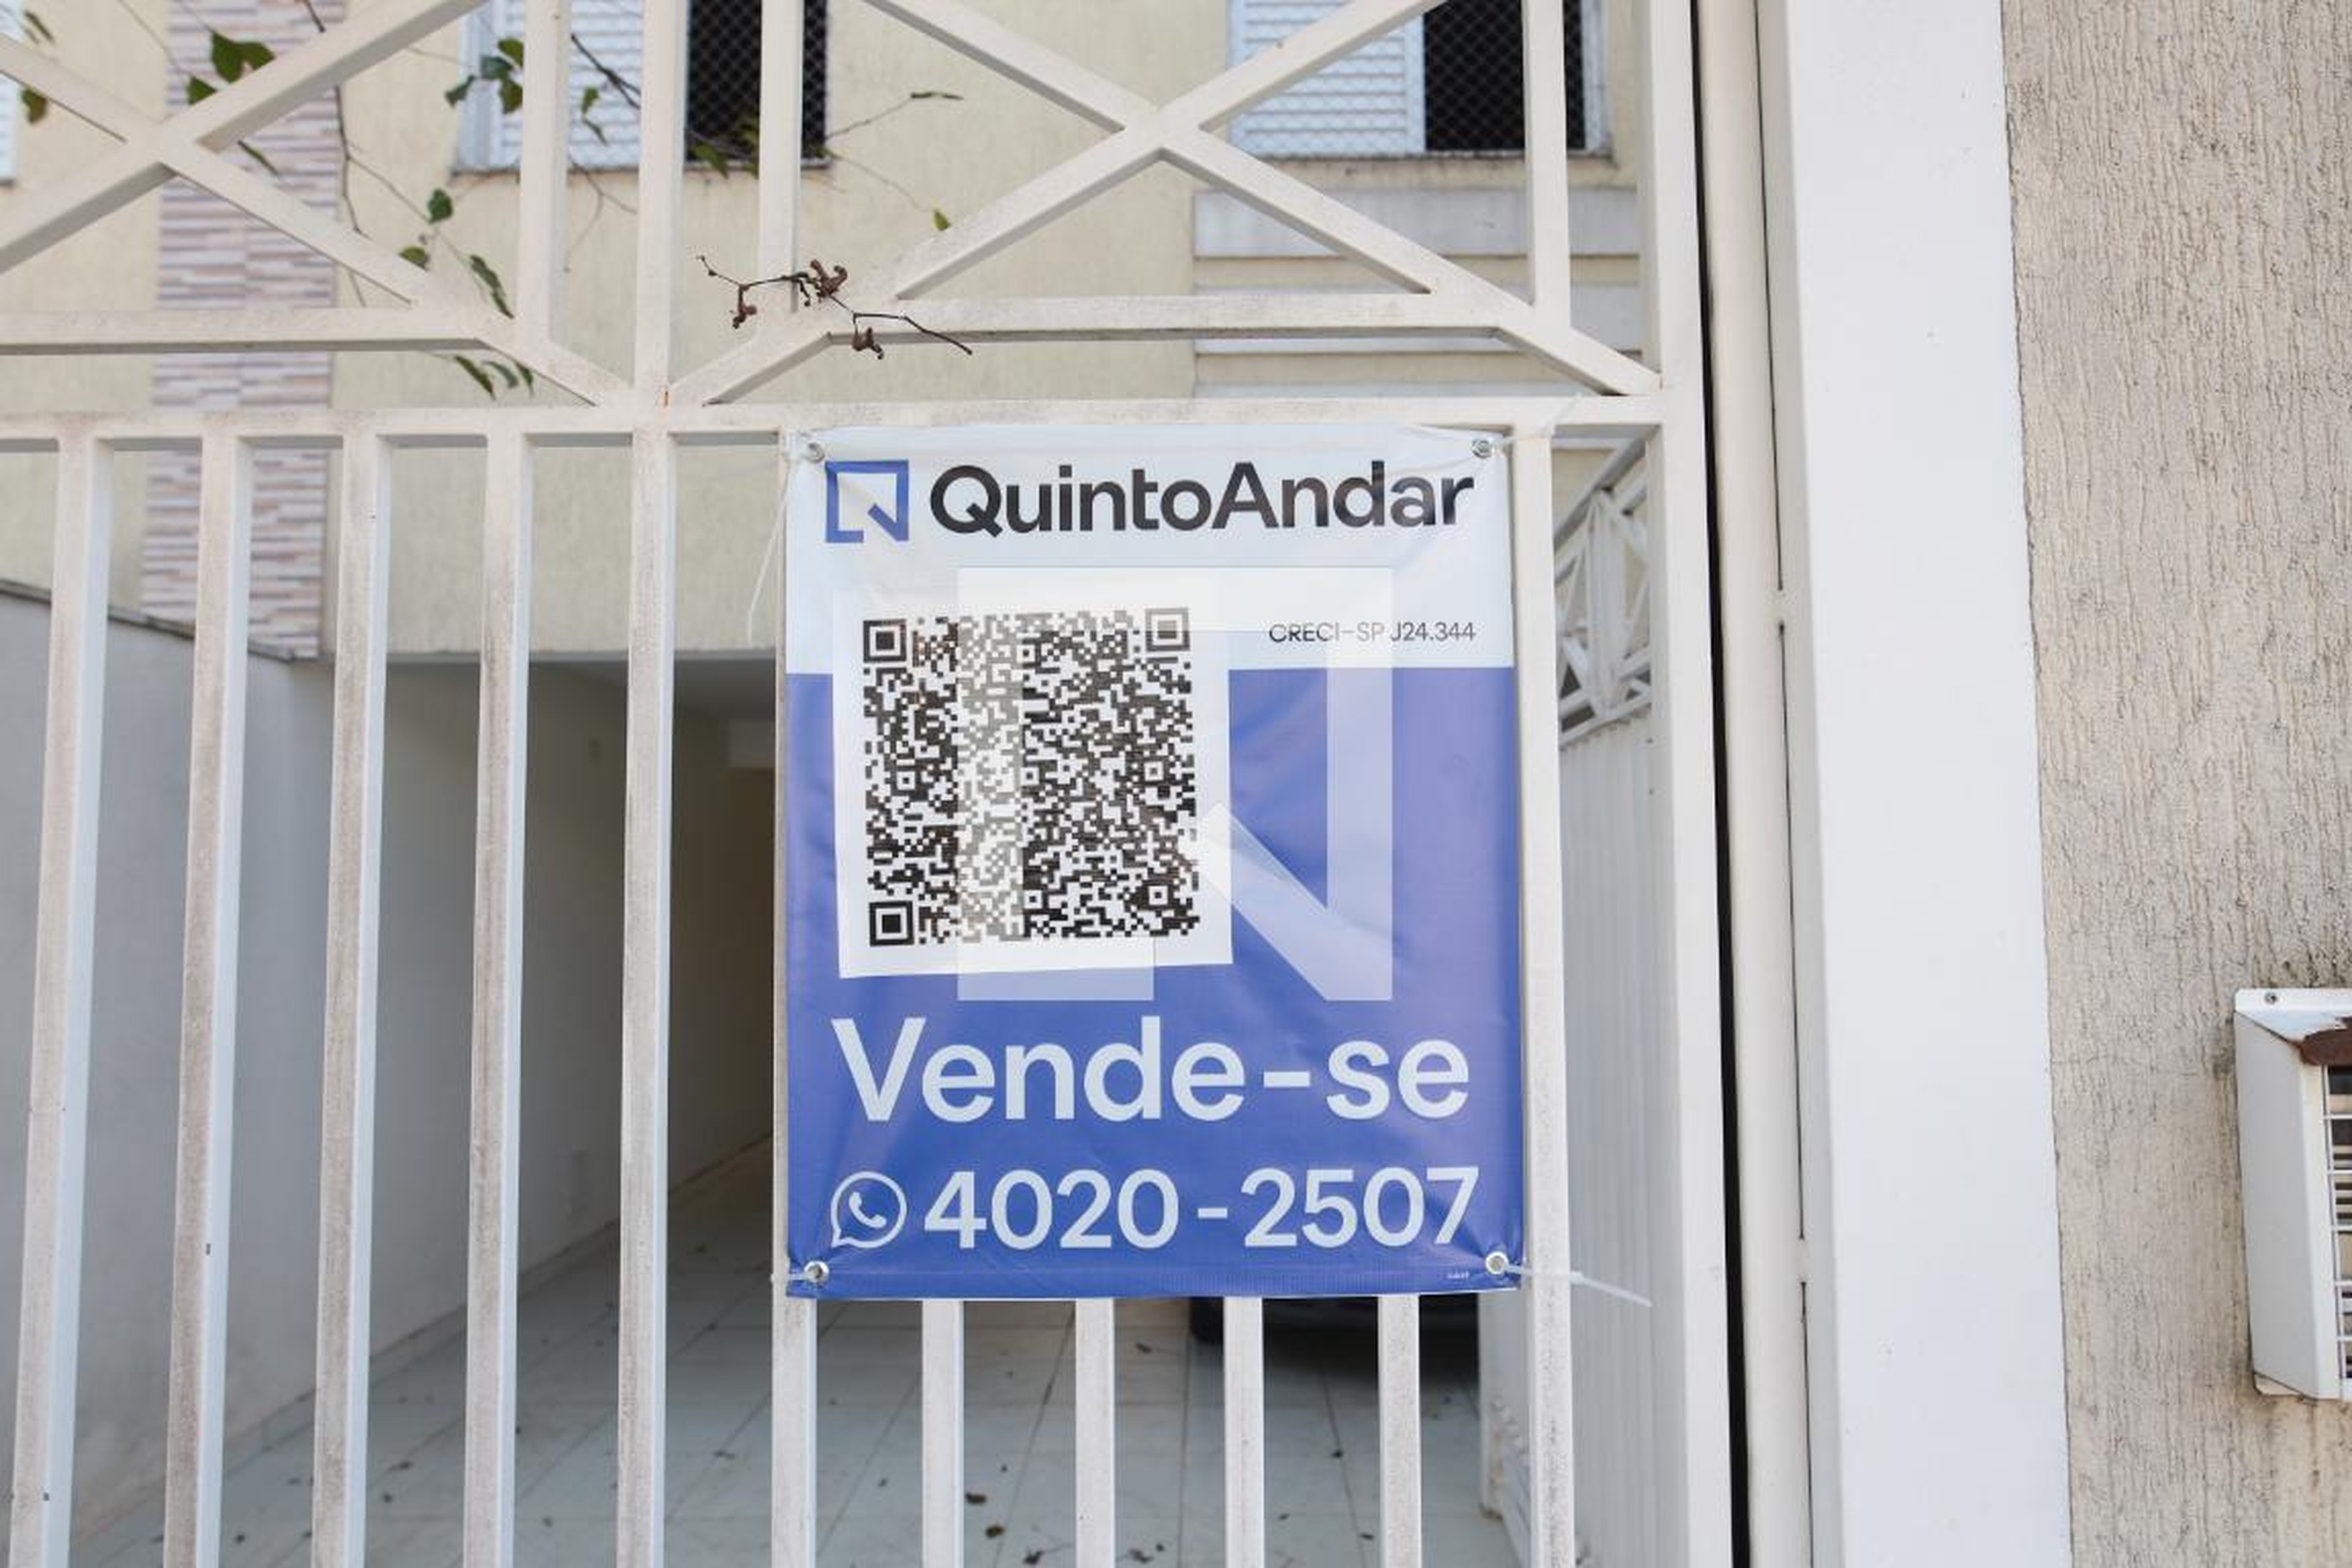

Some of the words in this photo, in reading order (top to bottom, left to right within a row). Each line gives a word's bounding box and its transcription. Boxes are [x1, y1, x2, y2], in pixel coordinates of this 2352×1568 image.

[930, 460, 1476, 538] QuintoAndar
[1390, 621, 1476, 642] J24.344
[831, 1016, 1470, 1123] Vende-se
